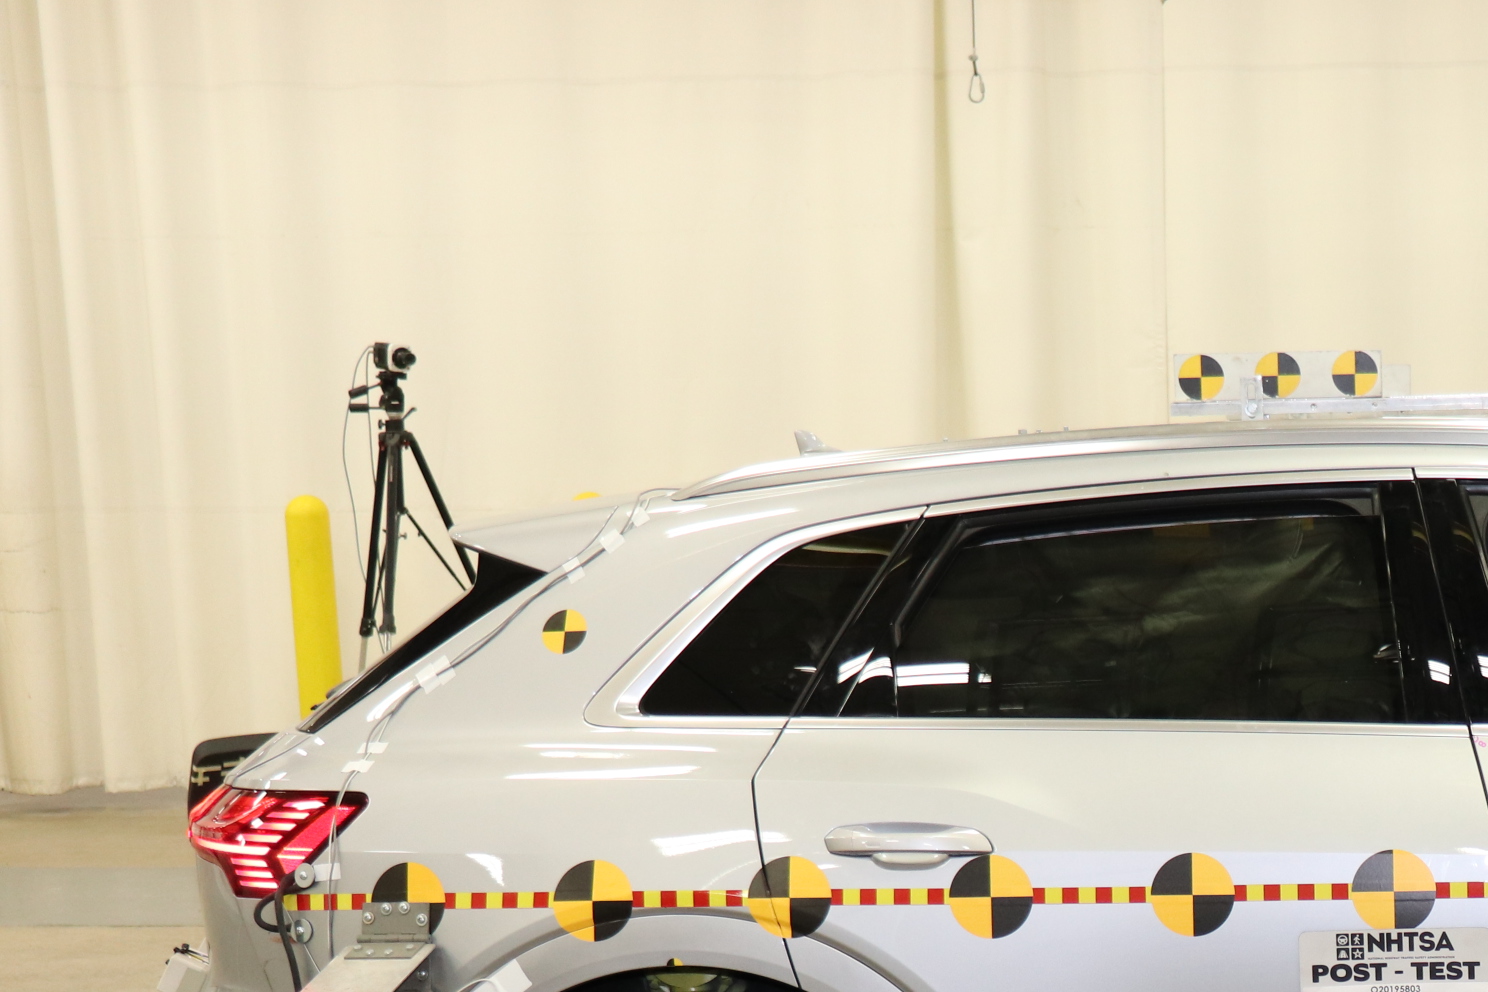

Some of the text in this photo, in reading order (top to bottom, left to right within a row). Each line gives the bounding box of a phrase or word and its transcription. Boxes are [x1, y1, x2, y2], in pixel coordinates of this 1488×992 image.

[1367, 931, 1455, 952] NHTSA
[1312, 963, 1388, 983] POST
[1410, 961, 1481, 981] TEST
